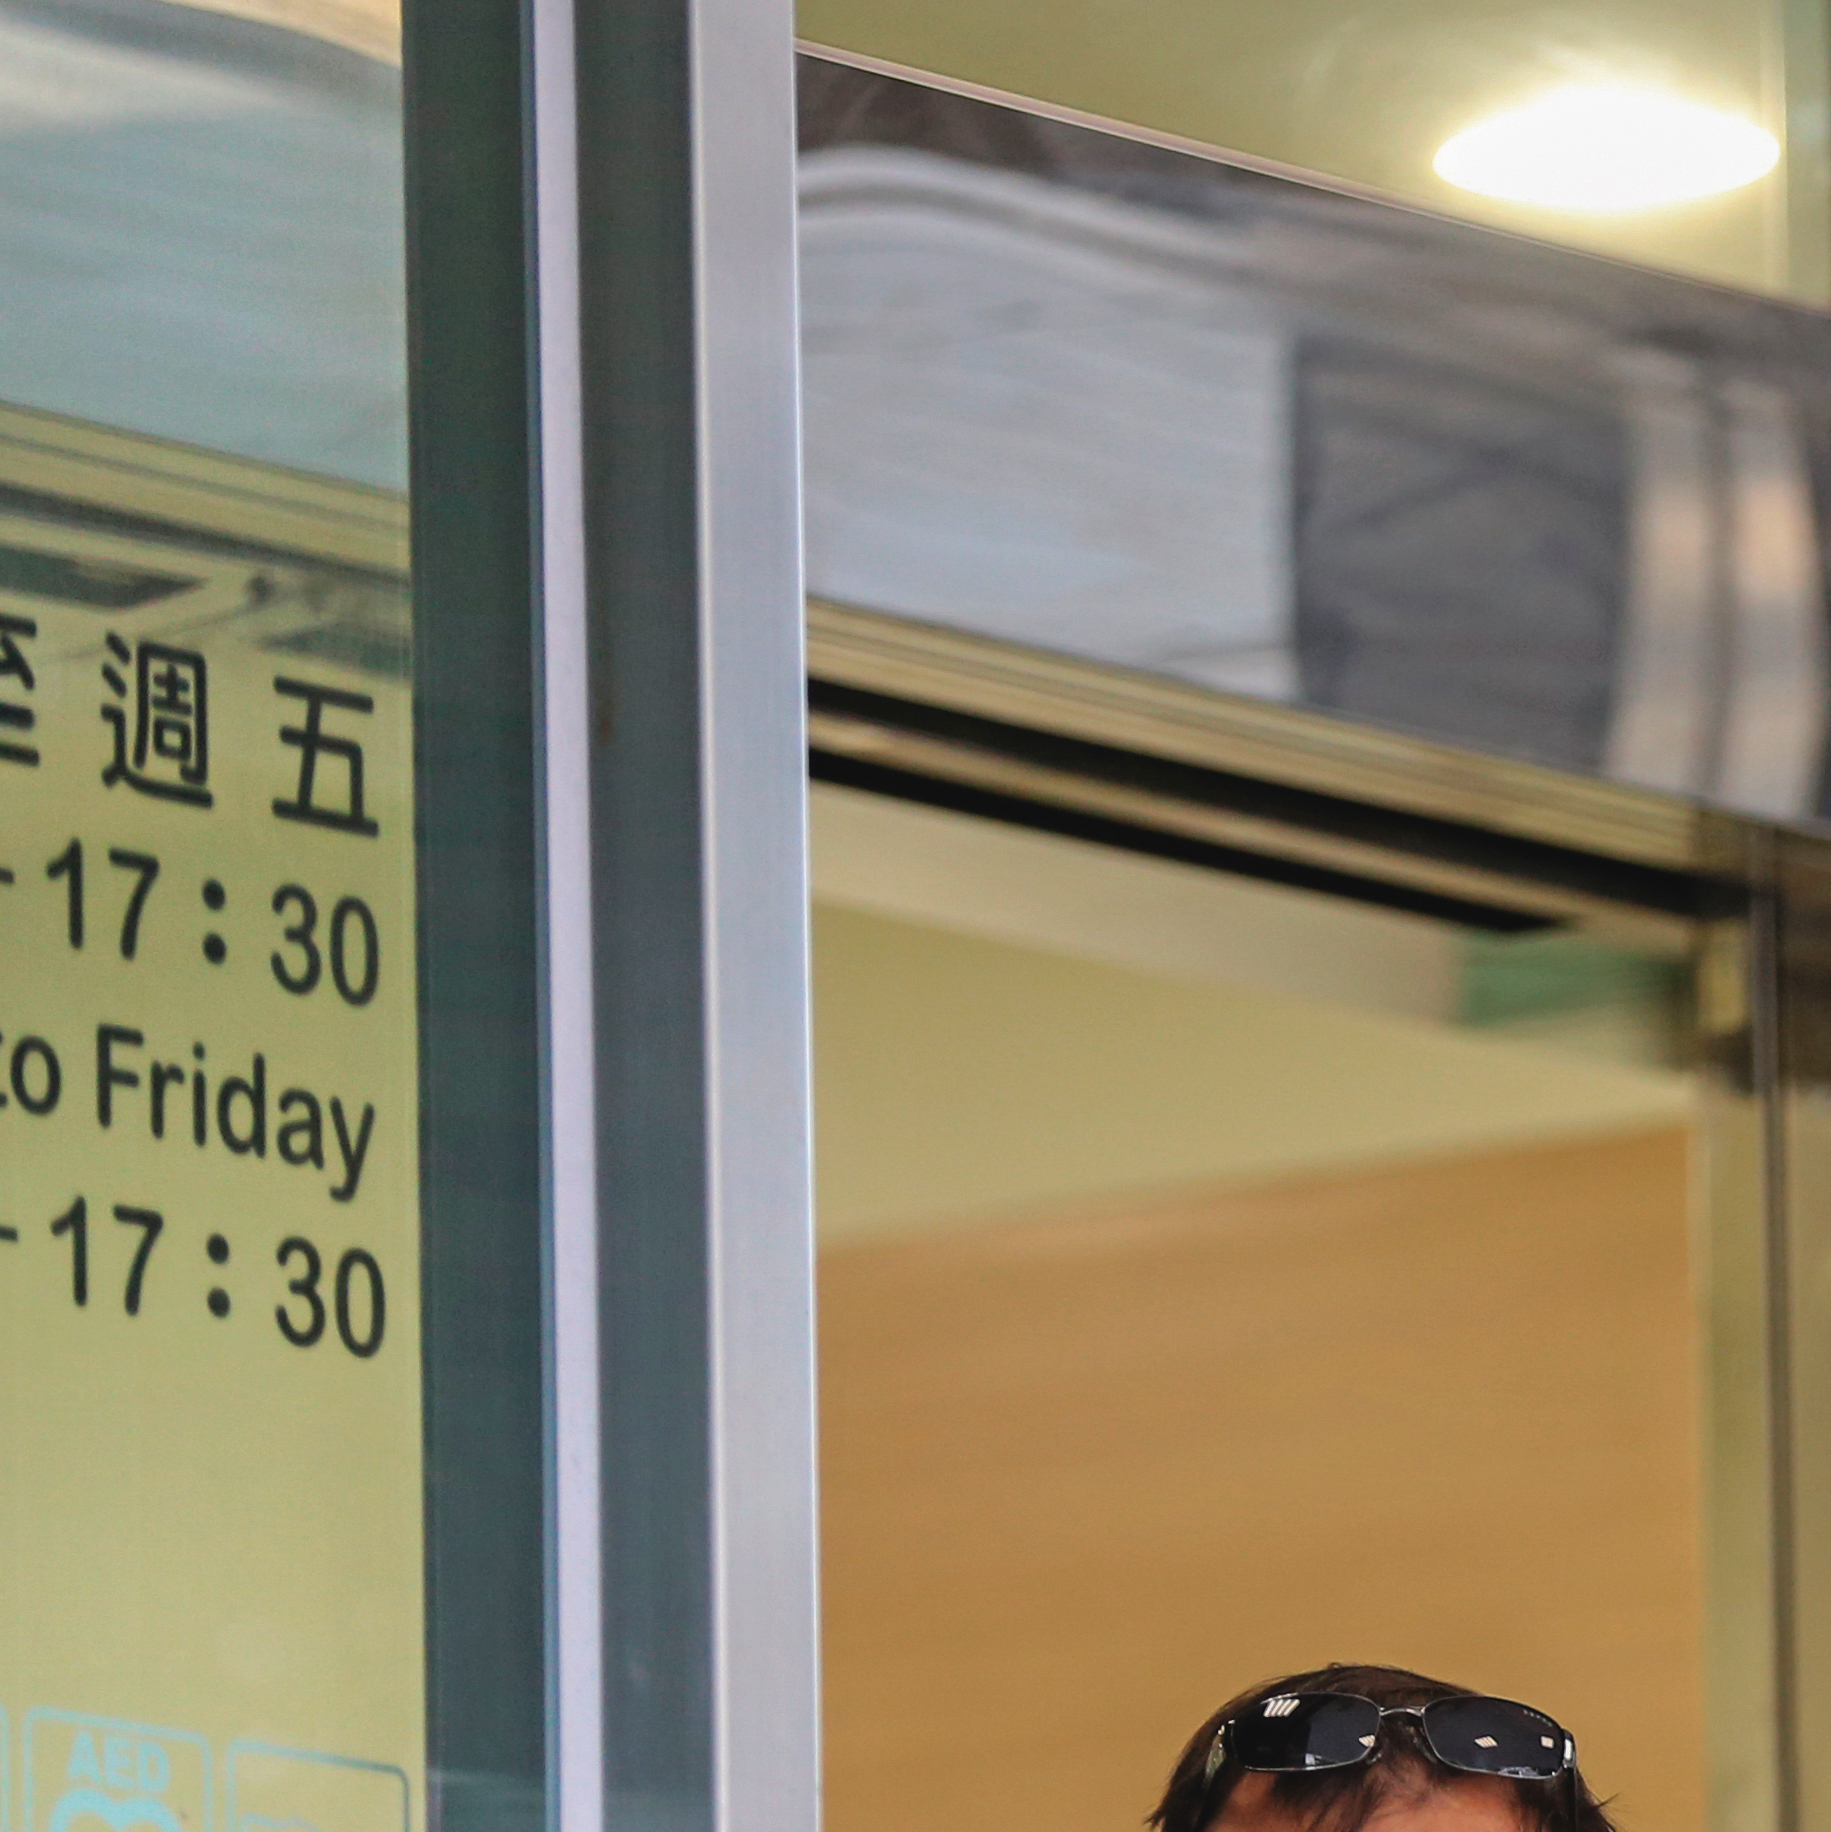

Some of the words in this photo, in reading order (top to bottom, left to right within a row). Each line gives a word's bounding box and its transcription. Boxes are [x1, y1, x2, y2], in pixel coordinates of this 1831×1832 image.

[0, 1033, 62, 1116] o
[97, 1022, 375, 1203] Friday
[68, 1733, 171, 1793] AED
